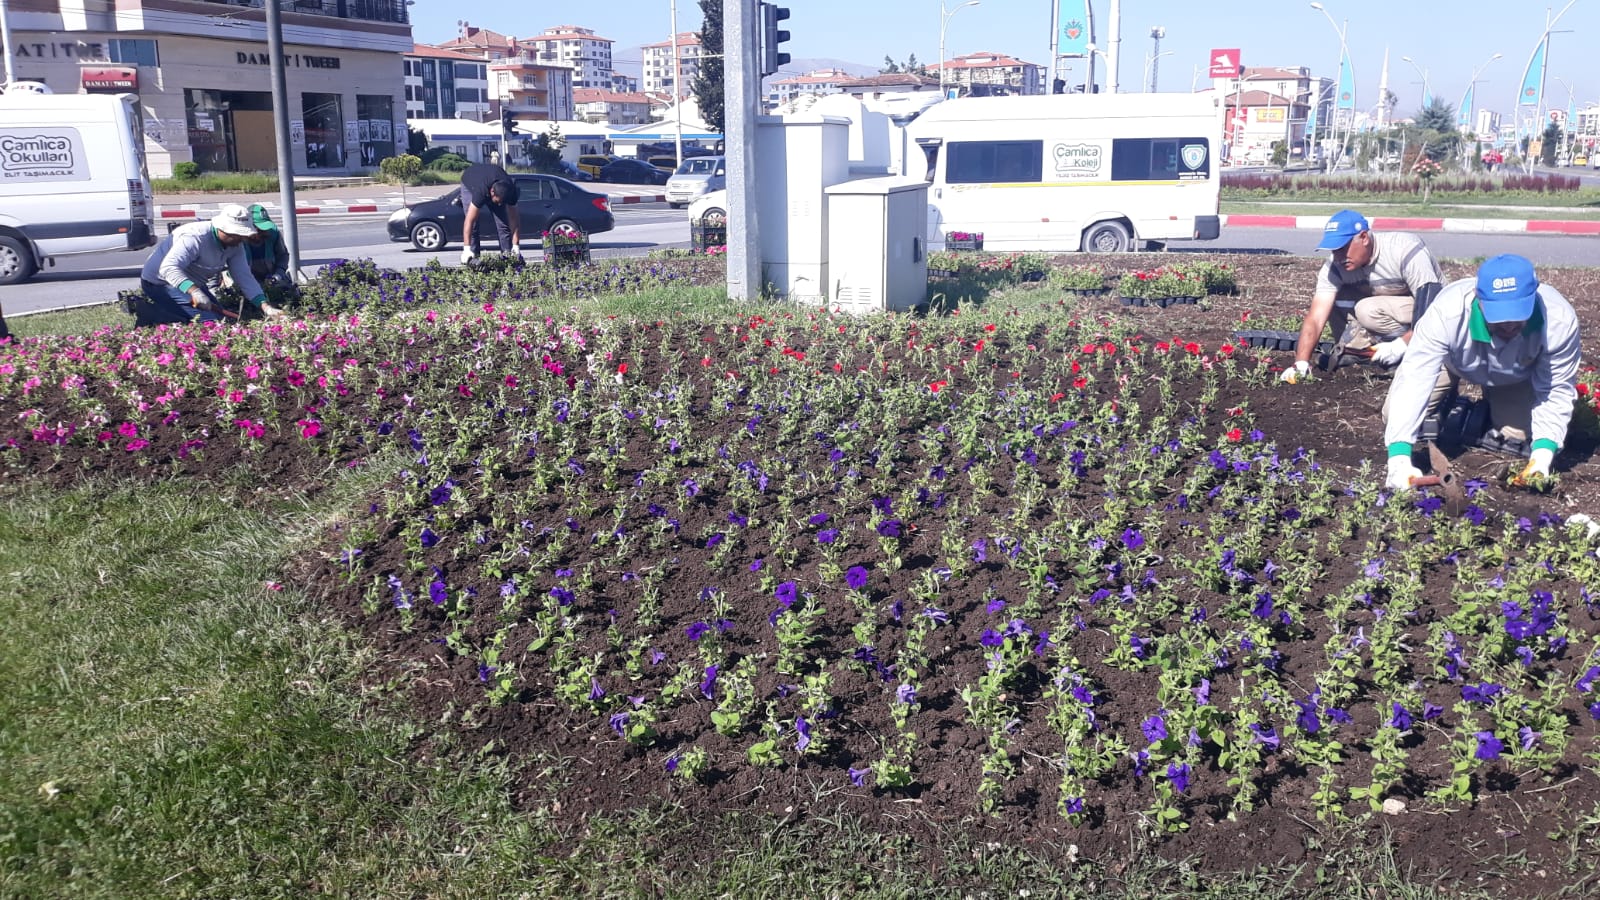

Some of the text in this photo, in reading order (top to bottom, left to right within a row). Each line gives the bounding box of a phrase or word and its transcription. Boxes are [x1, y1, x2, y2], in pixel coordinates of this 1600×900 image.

[0, 43, 46, 57] AT
[237, 52, 340, 69] DAMT TWEEN
[2, 139, 66, 153] Çamlıca
[10, 152, 67, 162] Okulları
[1074, 158, 1098, 168] Koleji
